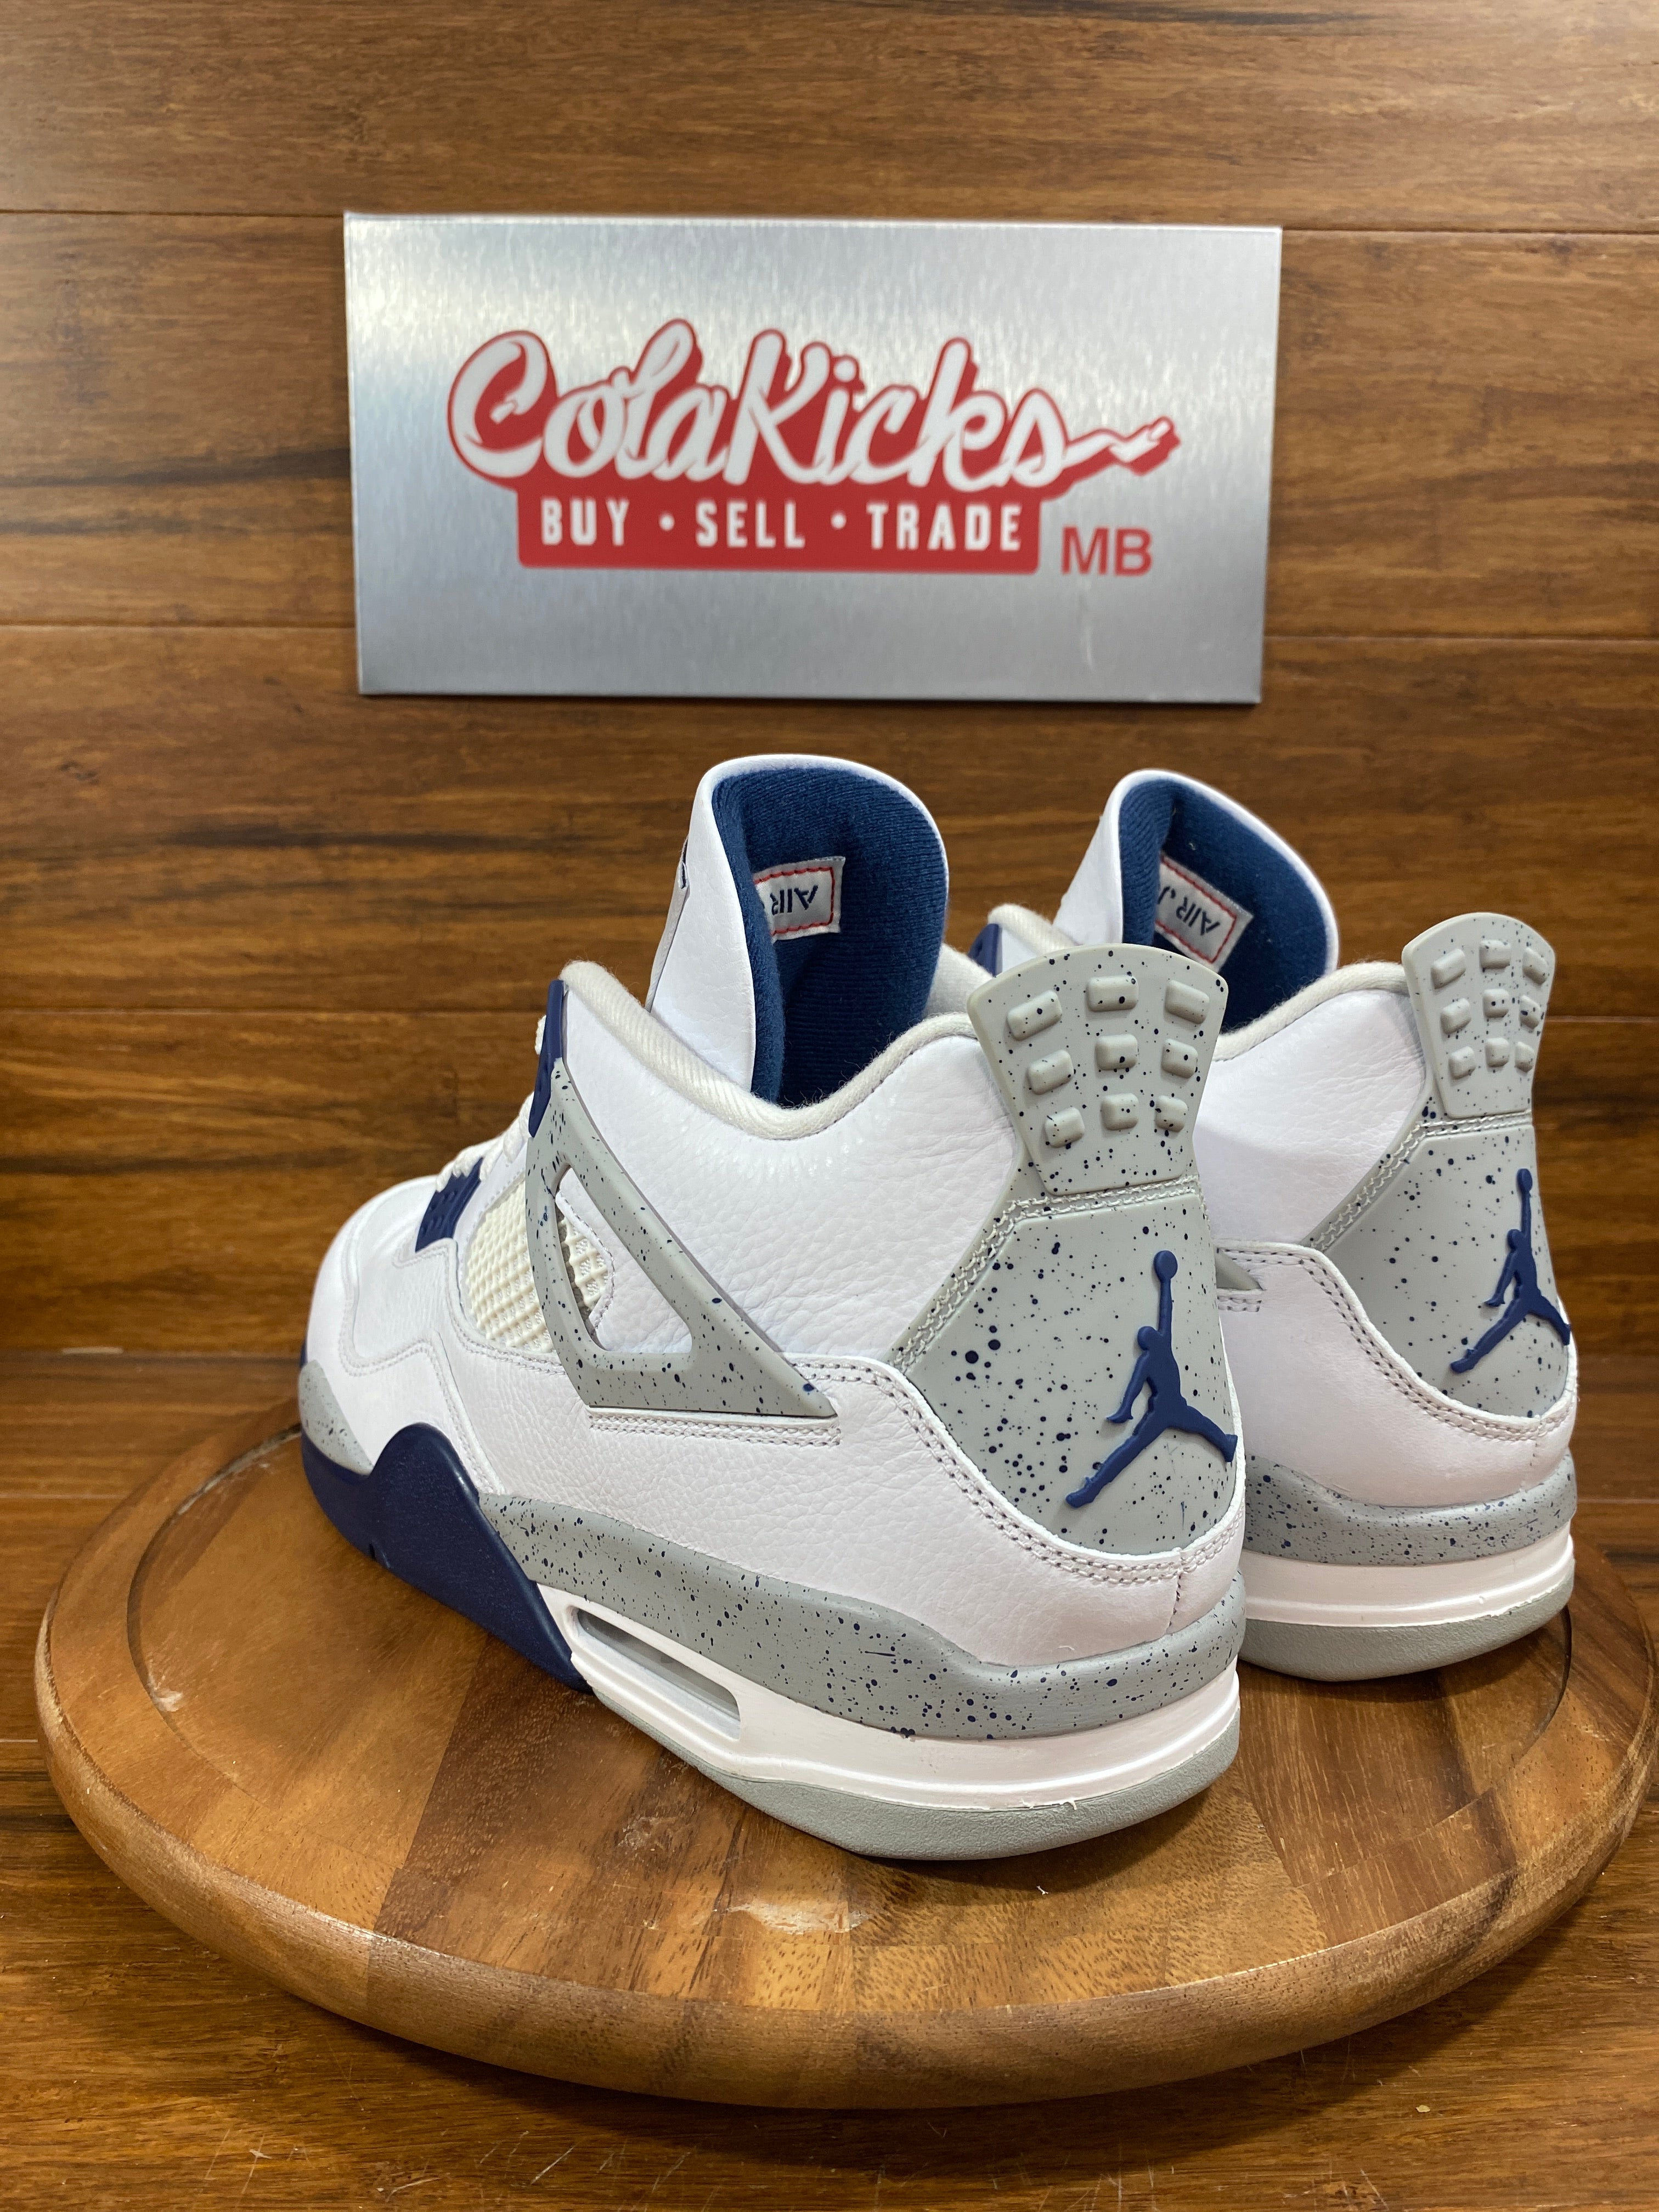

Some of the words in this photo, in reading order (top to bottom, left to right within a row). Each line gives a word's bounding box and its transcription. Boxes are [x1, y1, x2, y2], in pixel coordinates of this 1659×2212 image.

[447, 318, 1181, 493] ColaKicks
[540, 498, 629, 546] BUY
[695, 500, 805, 549] SELL
[866, 501, 1022, 552] TRADE
[1061, 526, 1153, 578] MB
[769, 884, 819, 916] AIR
[1175, 896, 1221, 936] AIR
